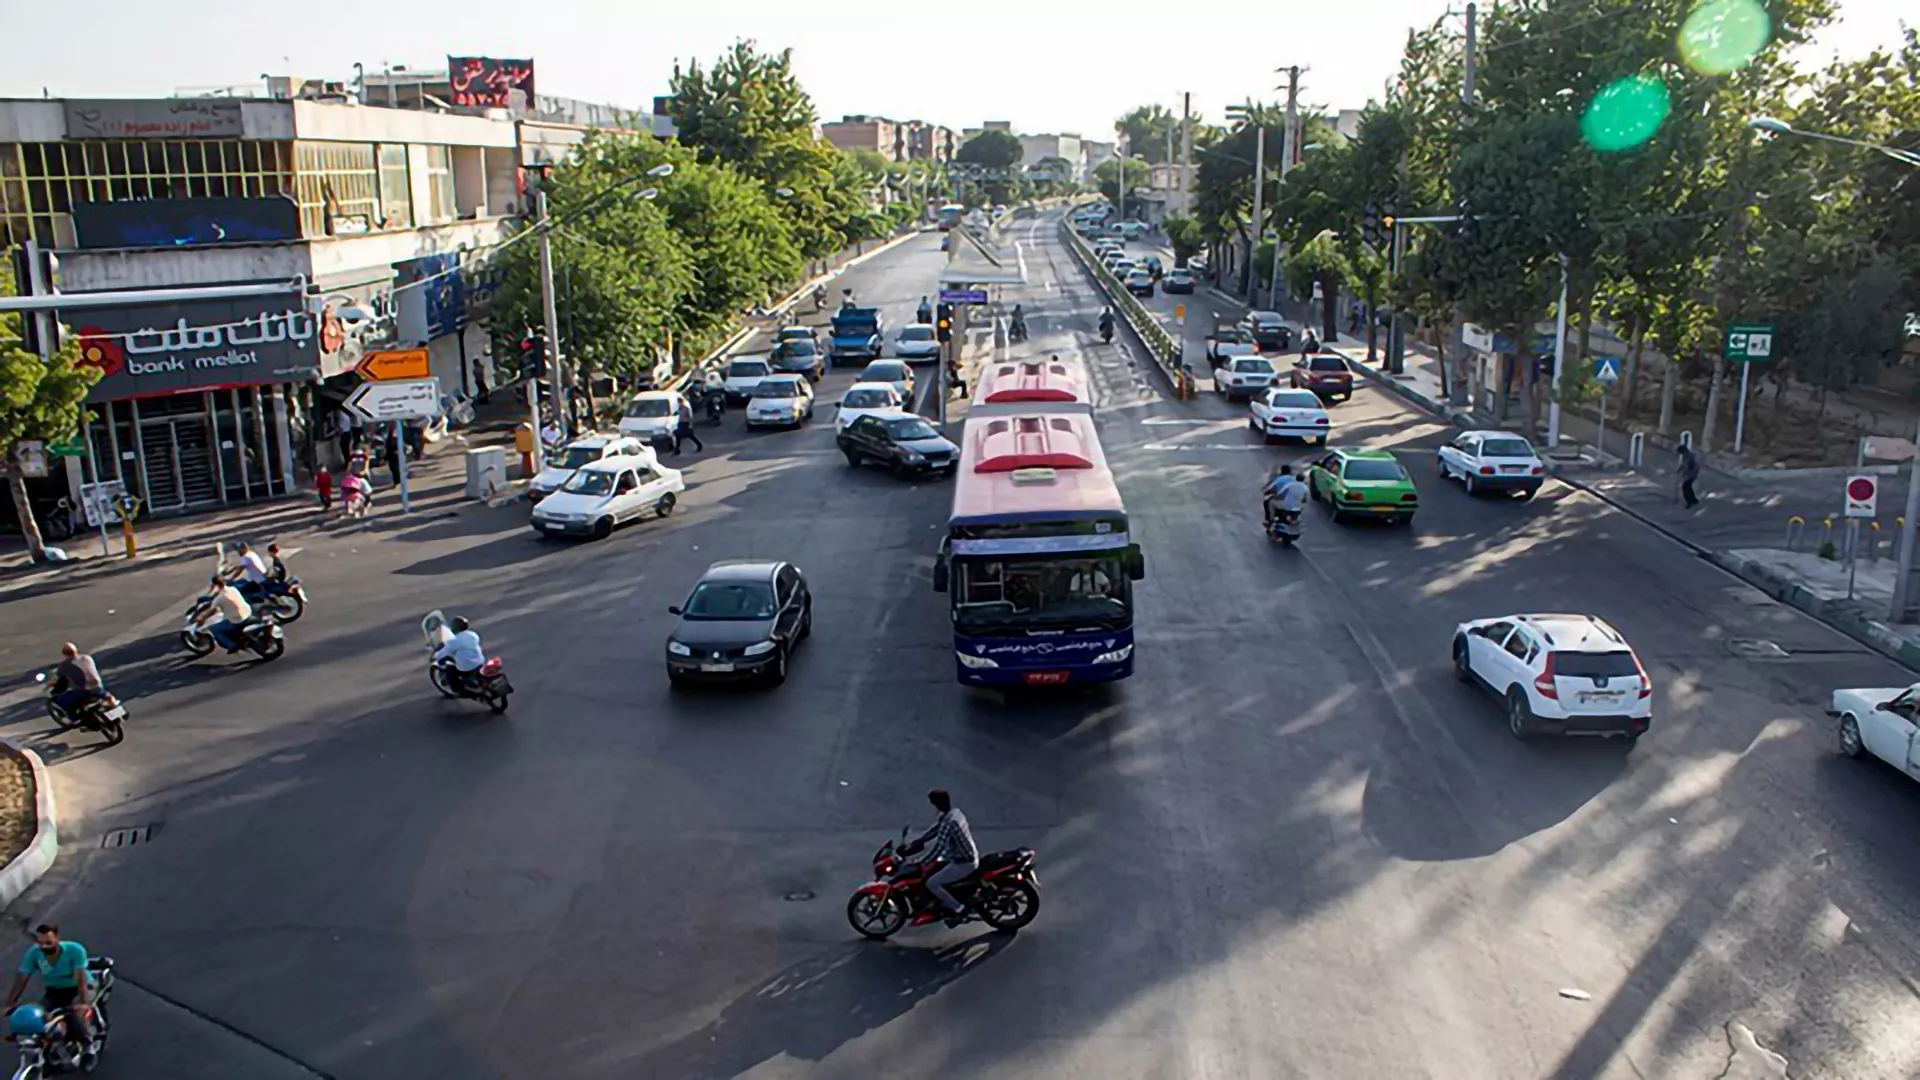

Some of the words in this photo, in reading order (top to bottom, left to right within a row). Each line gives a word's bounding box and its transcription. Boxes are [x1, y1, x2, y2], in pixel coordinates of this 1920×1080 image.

[124, 317, 222, 354] ملت
[128, 355, 185, 375] bank
[195, 349, 258, 369] mellat
